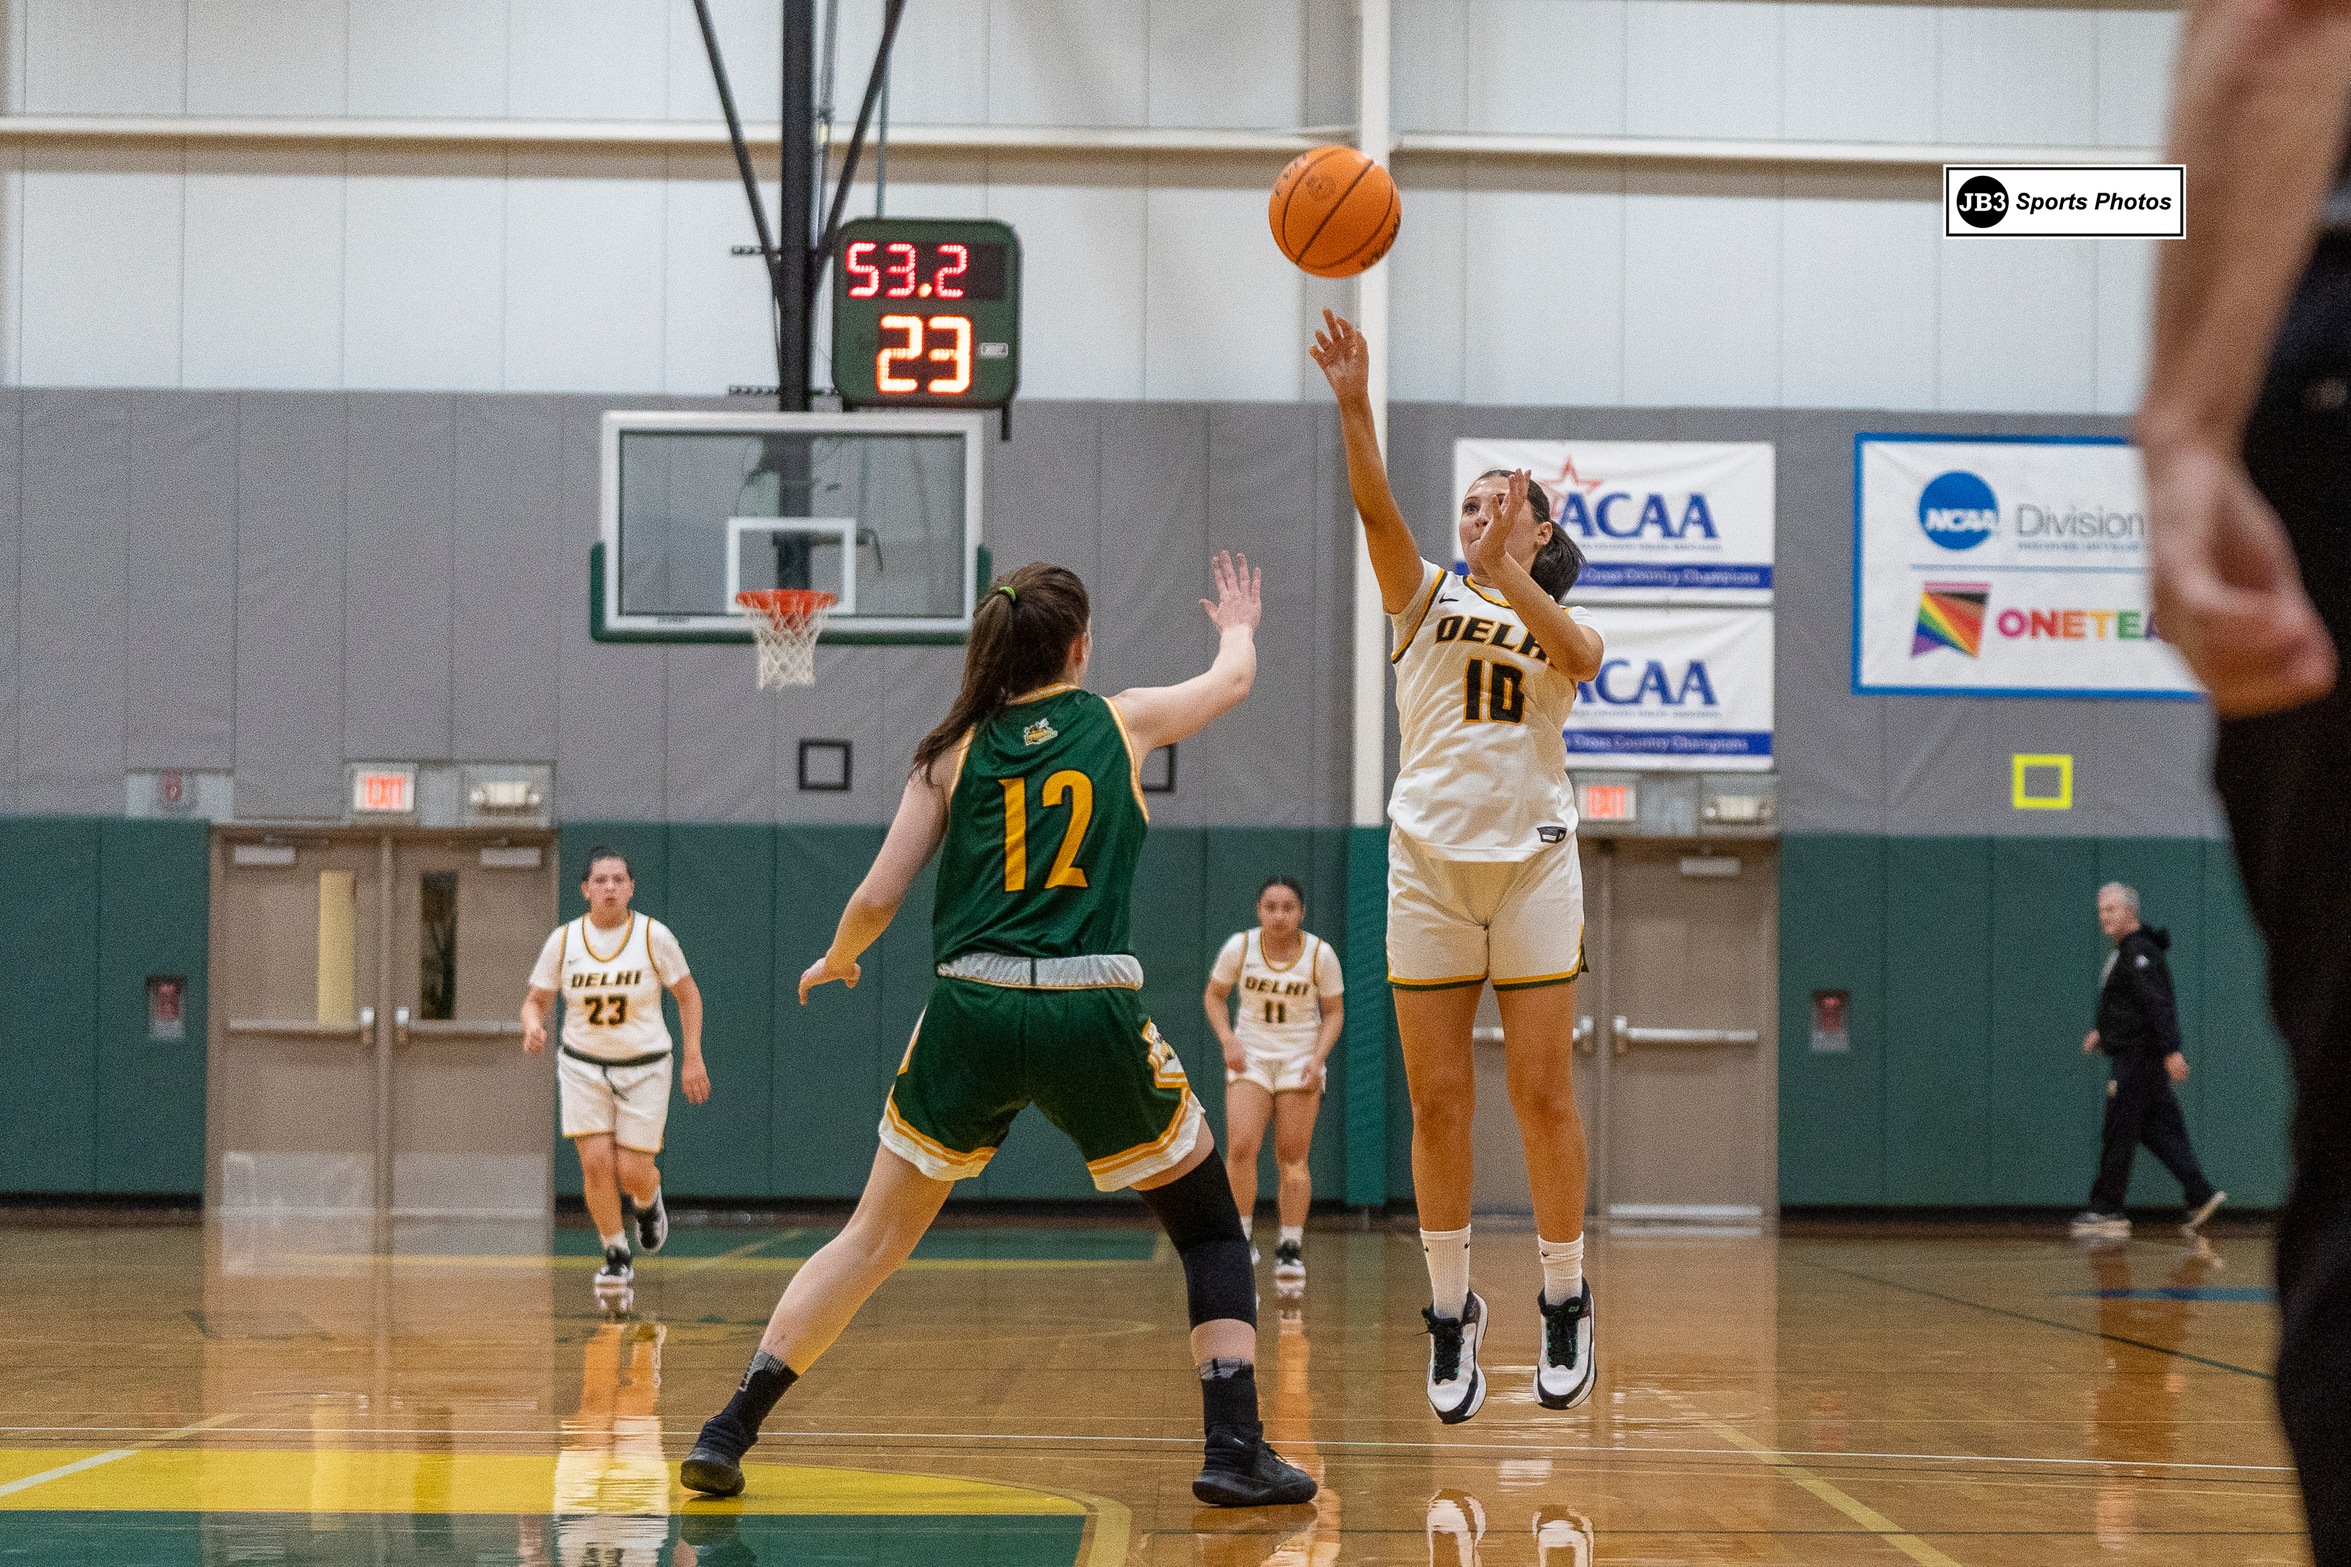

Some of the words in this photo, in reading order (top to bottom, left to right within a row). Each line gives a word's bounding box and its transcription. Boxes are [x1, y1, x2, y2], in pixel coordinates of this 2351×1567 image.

[846, 241, 968, 299] 53.2
[876, 314, 973, 394] 23
[1559, 491, 1720, 539] ACAA
[1924, 507, 2000, 532] NCAA
[2016, 503, 2146, 538] Division
[1434, 613, 1550, 665] DELH
[1463, 656, 1525, 725] 10
[998, 769, 1093, 892] 12
[571, 968, 642, 989] DELHI
[1245, 976, 1309, 996] DELHI
[584, 993, 628, 1027] 23
[1264, 999, 1286, 1024] 11
